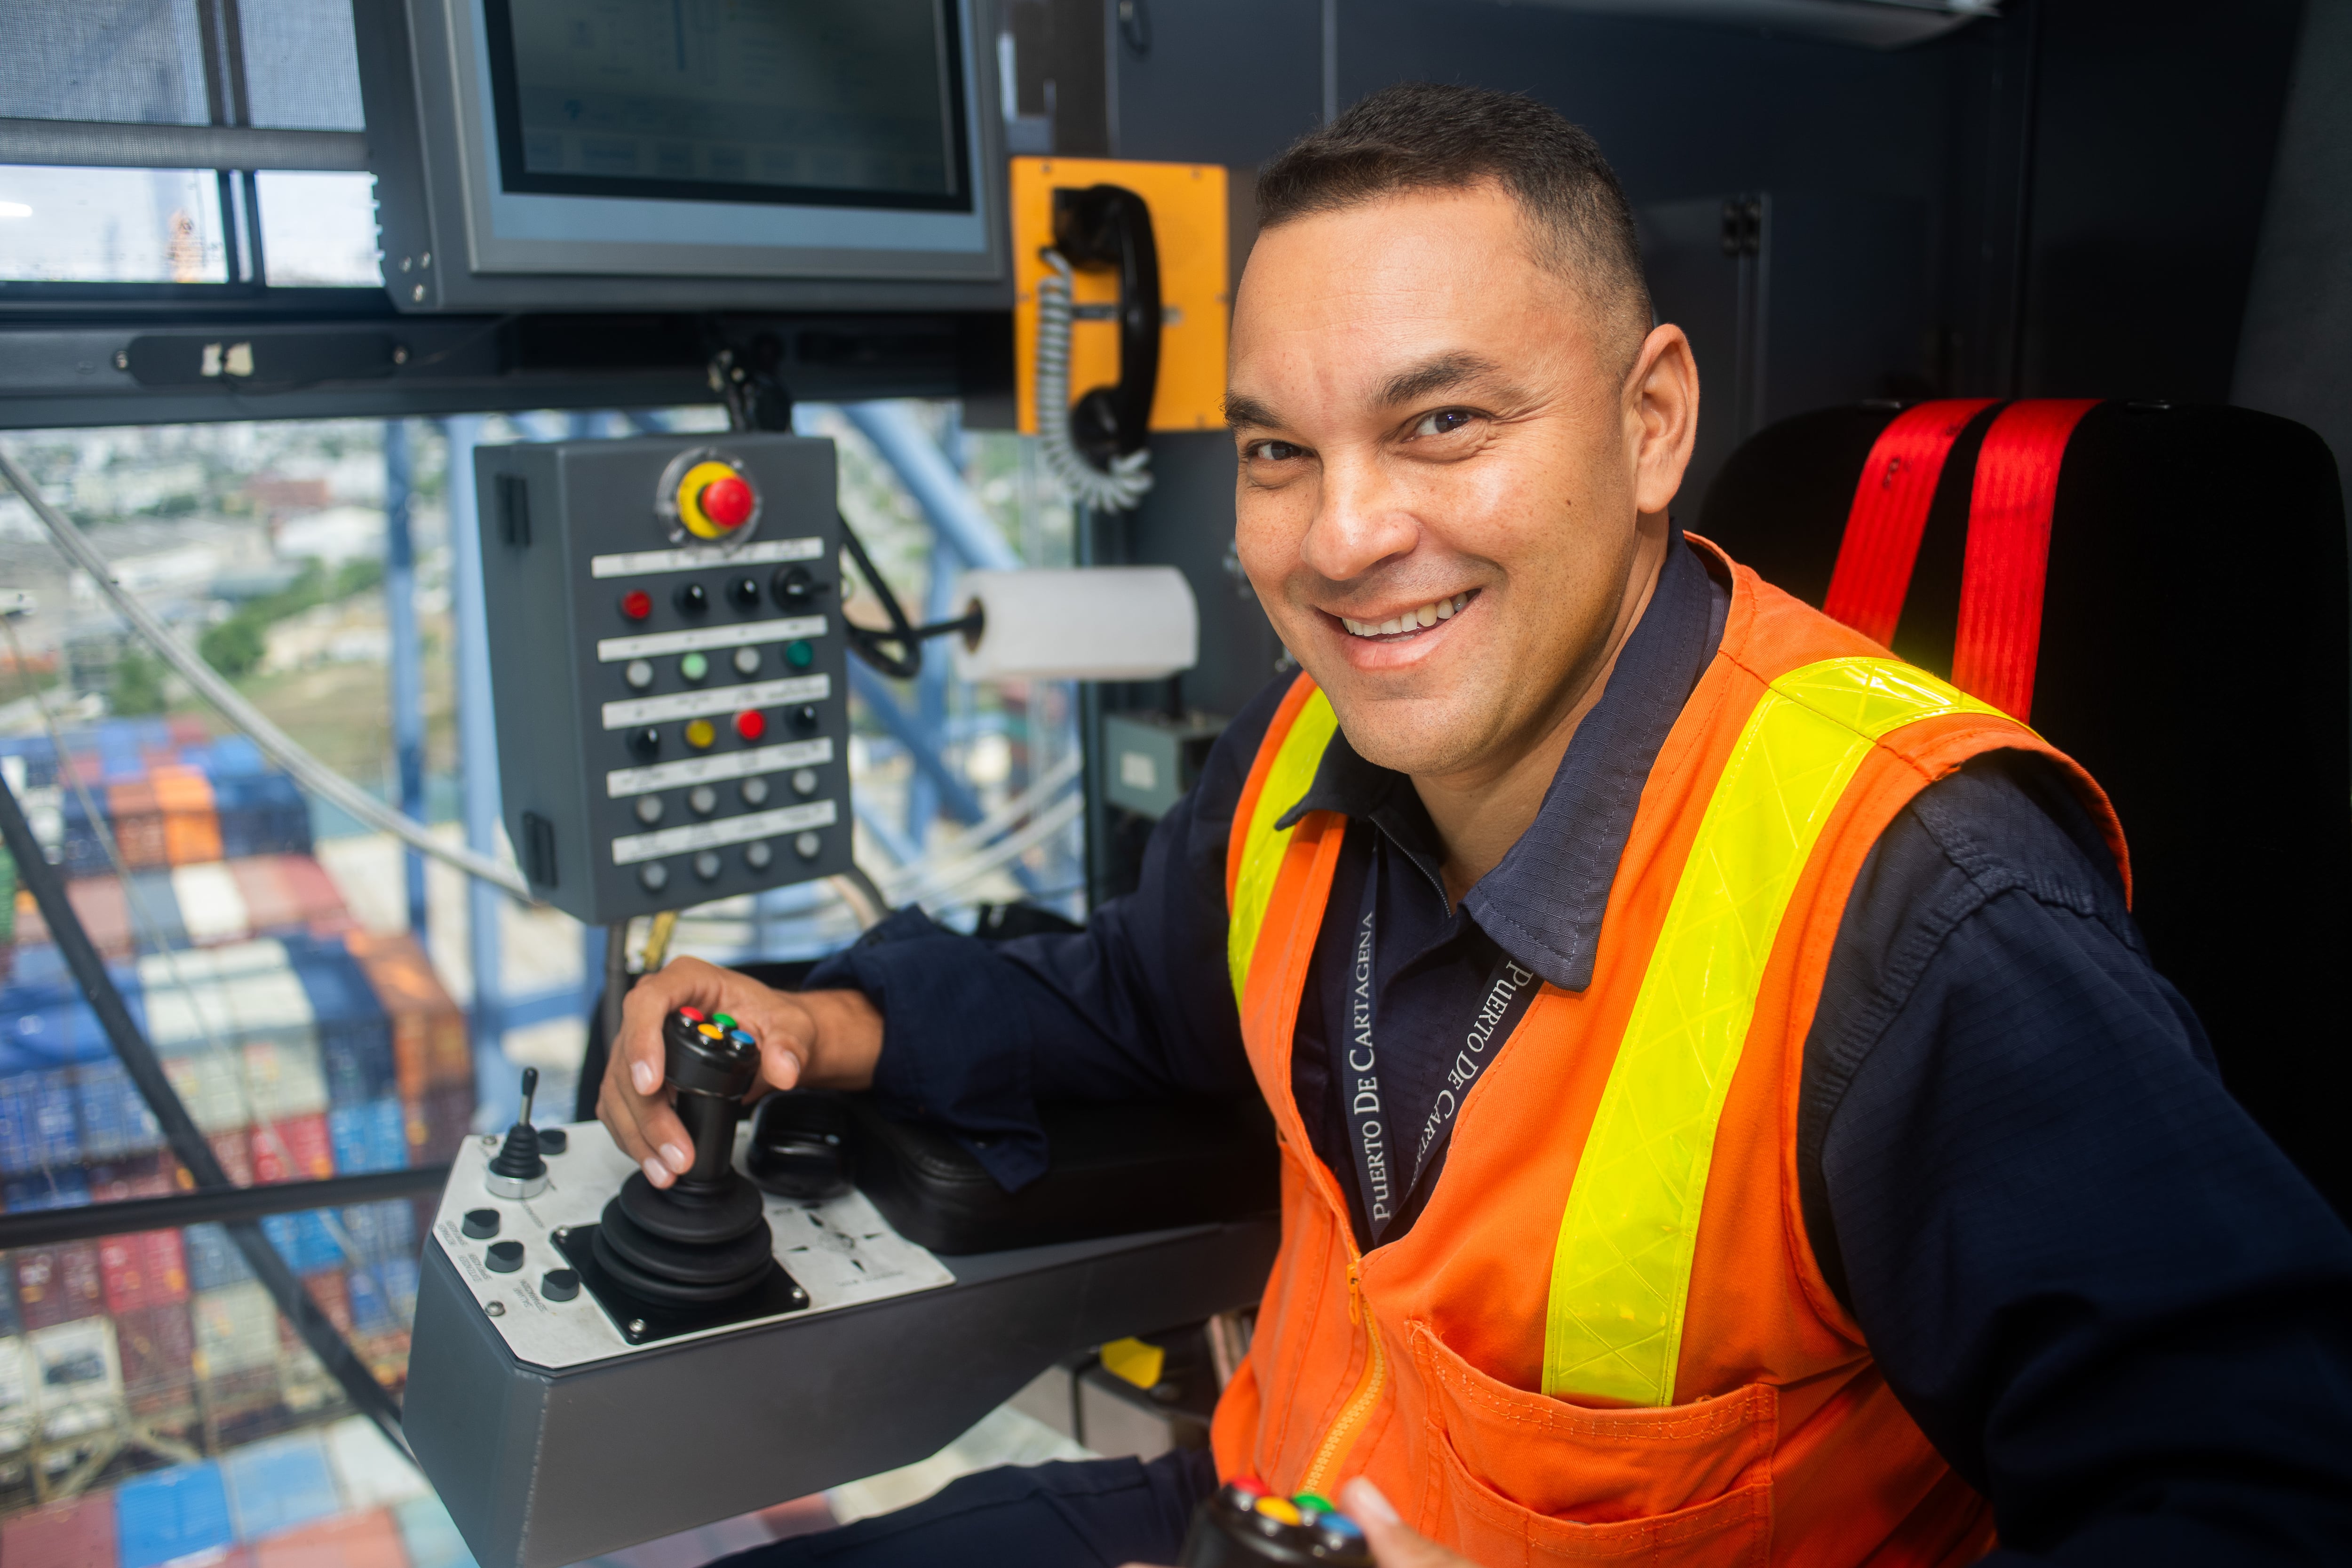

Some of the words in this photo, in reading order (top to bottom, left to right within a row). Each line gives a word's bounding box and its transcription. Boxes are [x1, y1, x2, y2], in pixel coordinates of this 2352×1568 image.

[1349, 911, 1376, 1071] CARTAGENA
[1467, 960, 1534, 1052] PUERTO
[1354, 1077, 1380, 1115] DE
[1447, 1050, 1478, 1090] DE
[1362, 1121, 1390, 1221] PUERTO
